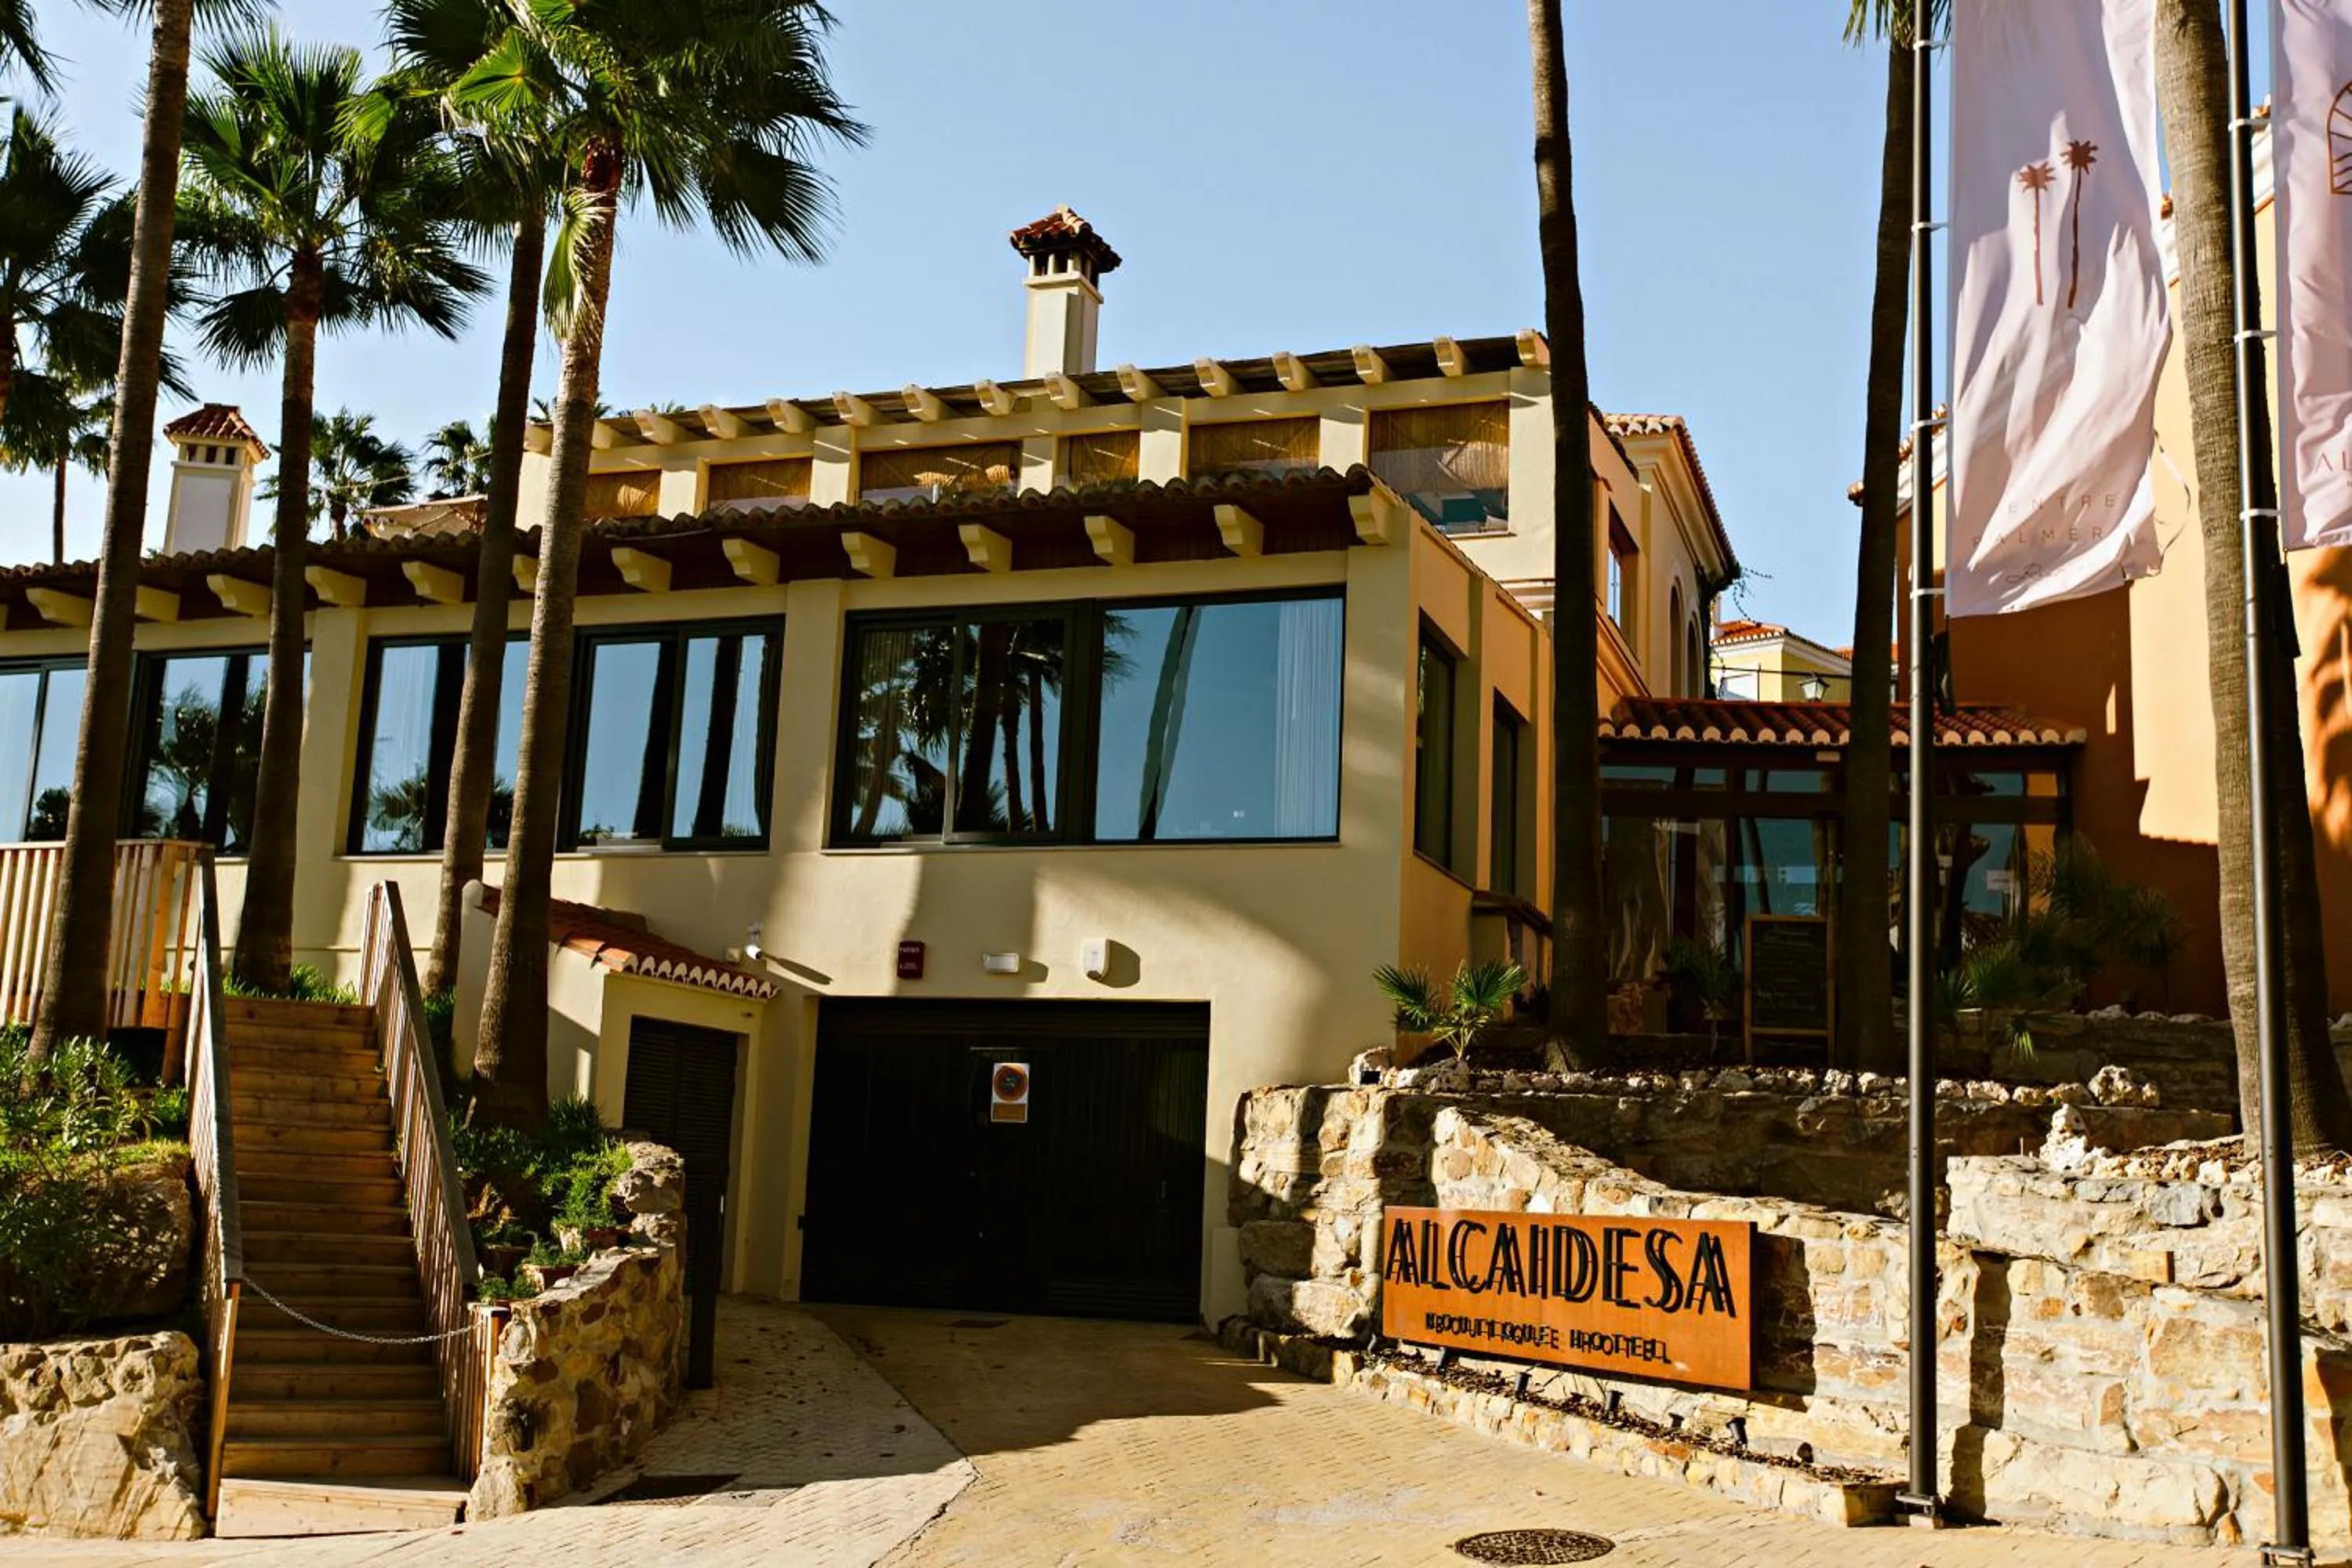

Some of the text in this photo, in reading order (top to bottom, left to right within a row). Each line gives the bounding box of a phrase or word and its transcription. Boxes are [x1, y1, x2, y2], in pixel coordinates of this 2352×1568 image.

[2008, 493, 2116, 514] ENTRE
[1385, 1218, 1737, 1319] ALCAIDESA
[1425, 1312, 1672, 1364] BOUTIQUE HOTEL
